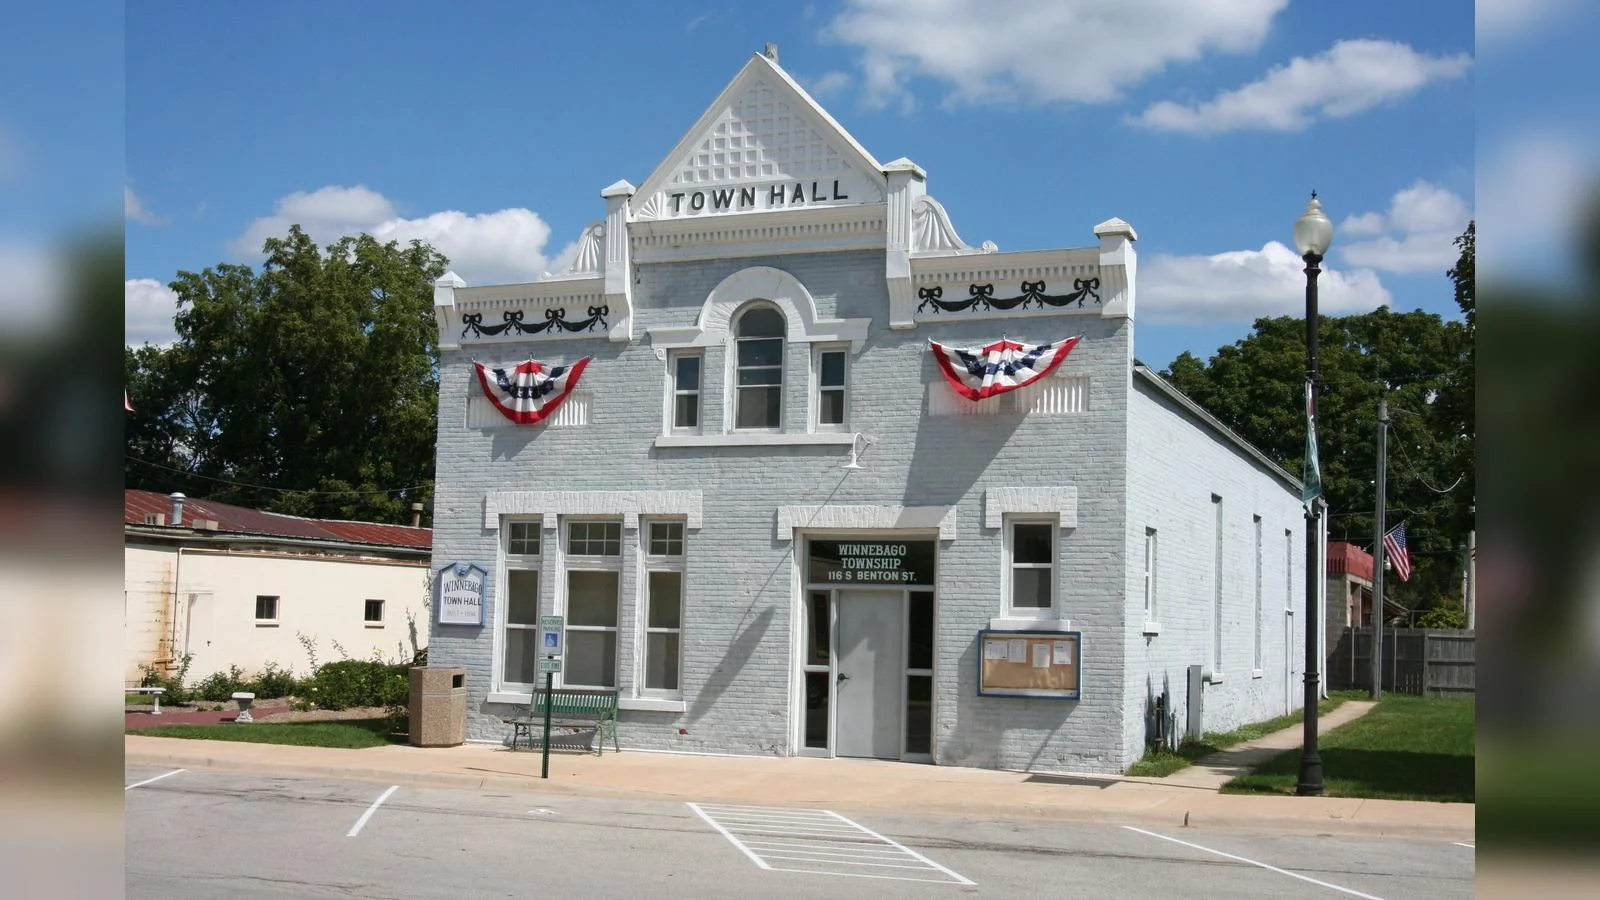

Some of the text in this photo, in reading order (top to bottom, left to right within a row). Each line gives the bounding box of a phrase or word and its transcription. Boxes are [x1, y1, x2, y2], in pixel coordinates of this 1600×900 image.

[672, 180, 848, 212] TOWN HALL
[839, 544, 907, 556] WINNEBAGO
[841, 557, 902, 569] TOWNSHIP
[828, 571, 917, 581] 116 S BENTON ST.
[444, 579, 483, 595] WINNEBAGO
[444, 596, 482, 606] TOWN HALL
